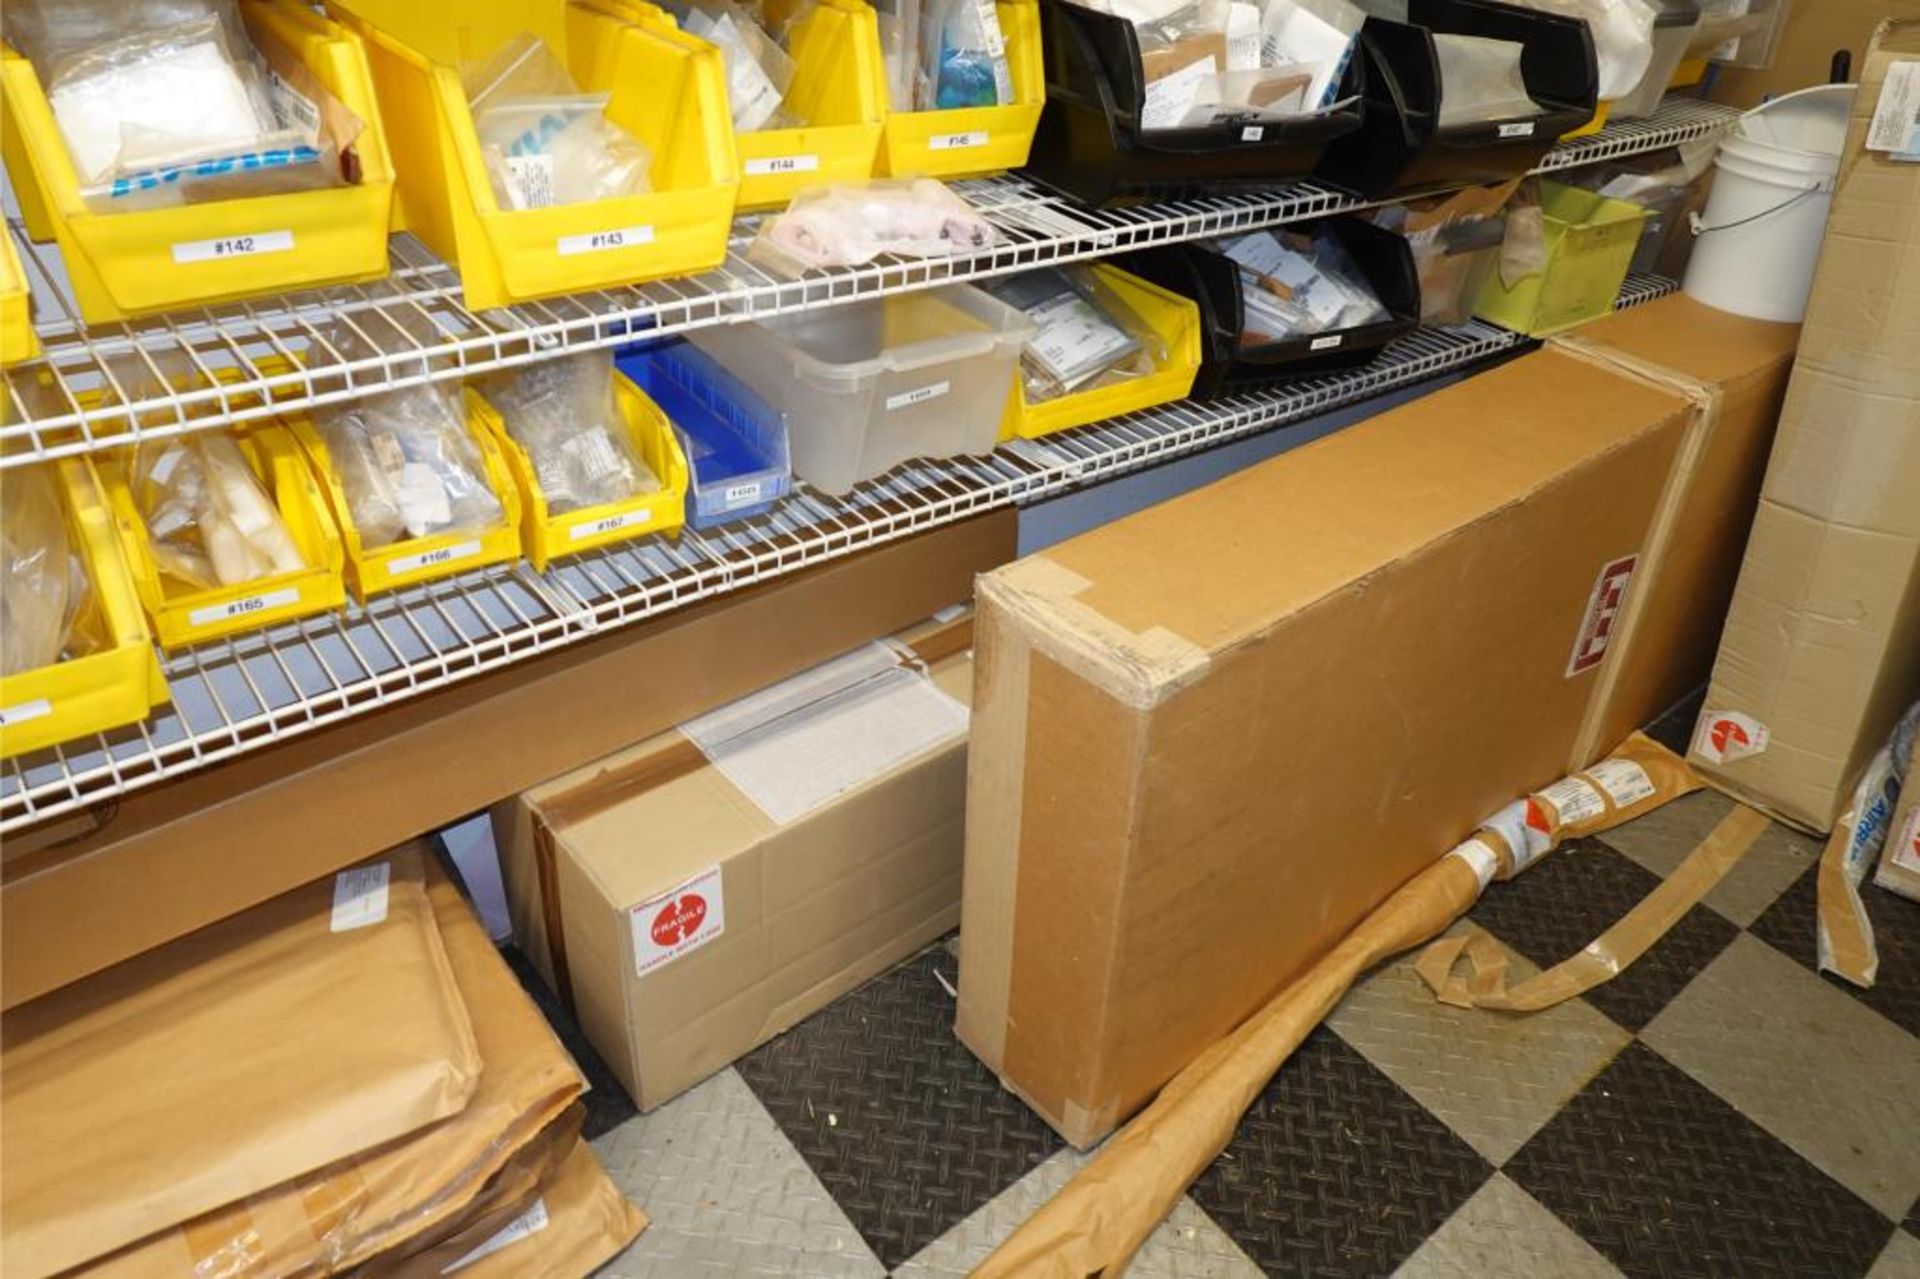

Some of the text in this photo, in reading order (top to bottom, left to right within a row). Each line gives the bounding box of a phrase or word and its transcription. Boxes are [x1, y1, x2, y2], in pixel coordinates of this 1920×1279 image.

[769, 160, 794, 171] #144
[214, 237, 254, 255] #142
[591, 231, 623, 248] #143
[598, 516, 623, 531] #167
[227, 598, 263, 615] #165
[653, 903, 705, 938] FRAGILE
